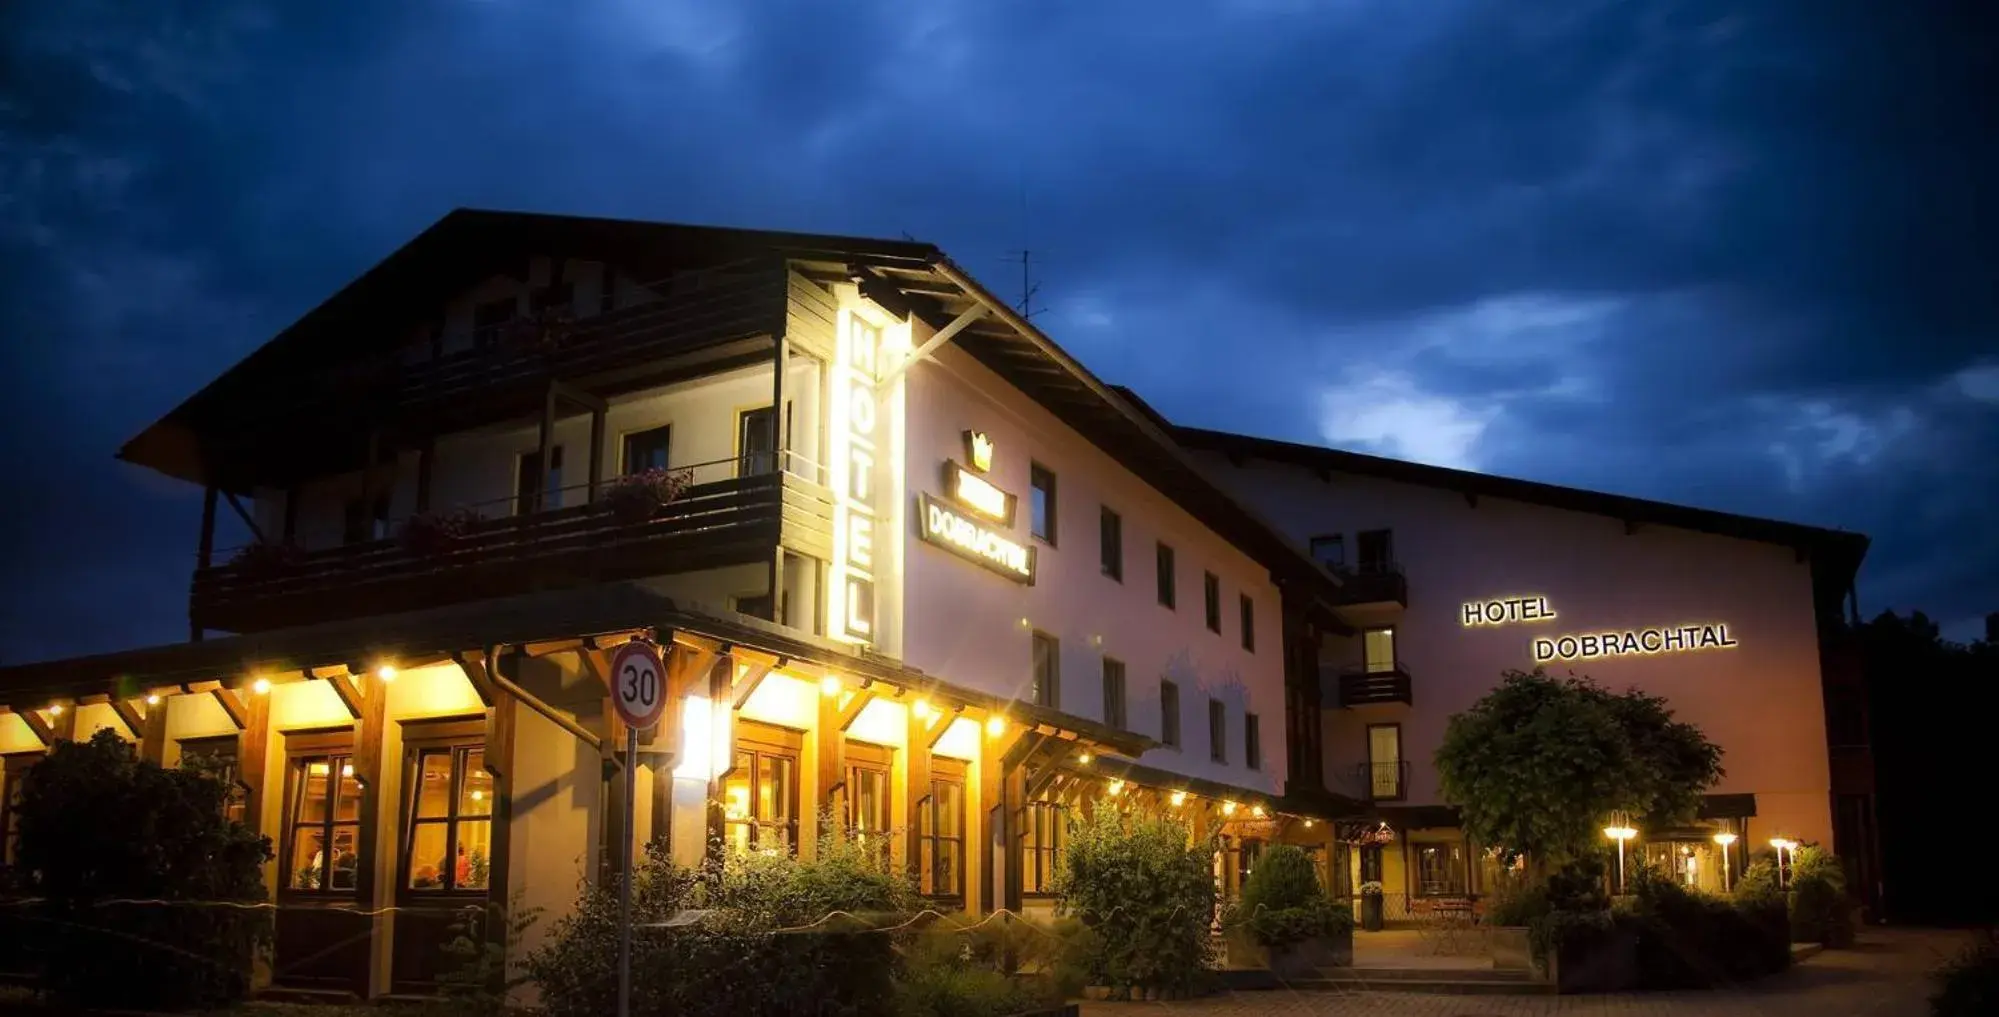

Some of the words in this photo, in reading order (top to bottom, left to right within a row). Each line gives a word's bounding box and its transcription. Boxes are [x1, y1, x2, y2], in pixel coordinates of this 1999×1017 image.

[850, 319, 876, 634] HOTEL
[1463, 597, 1555, 625] HOTEL
[1535, 624, 1737, 661] DOBRACHTAL
[622, 664, 655, 707] 30
